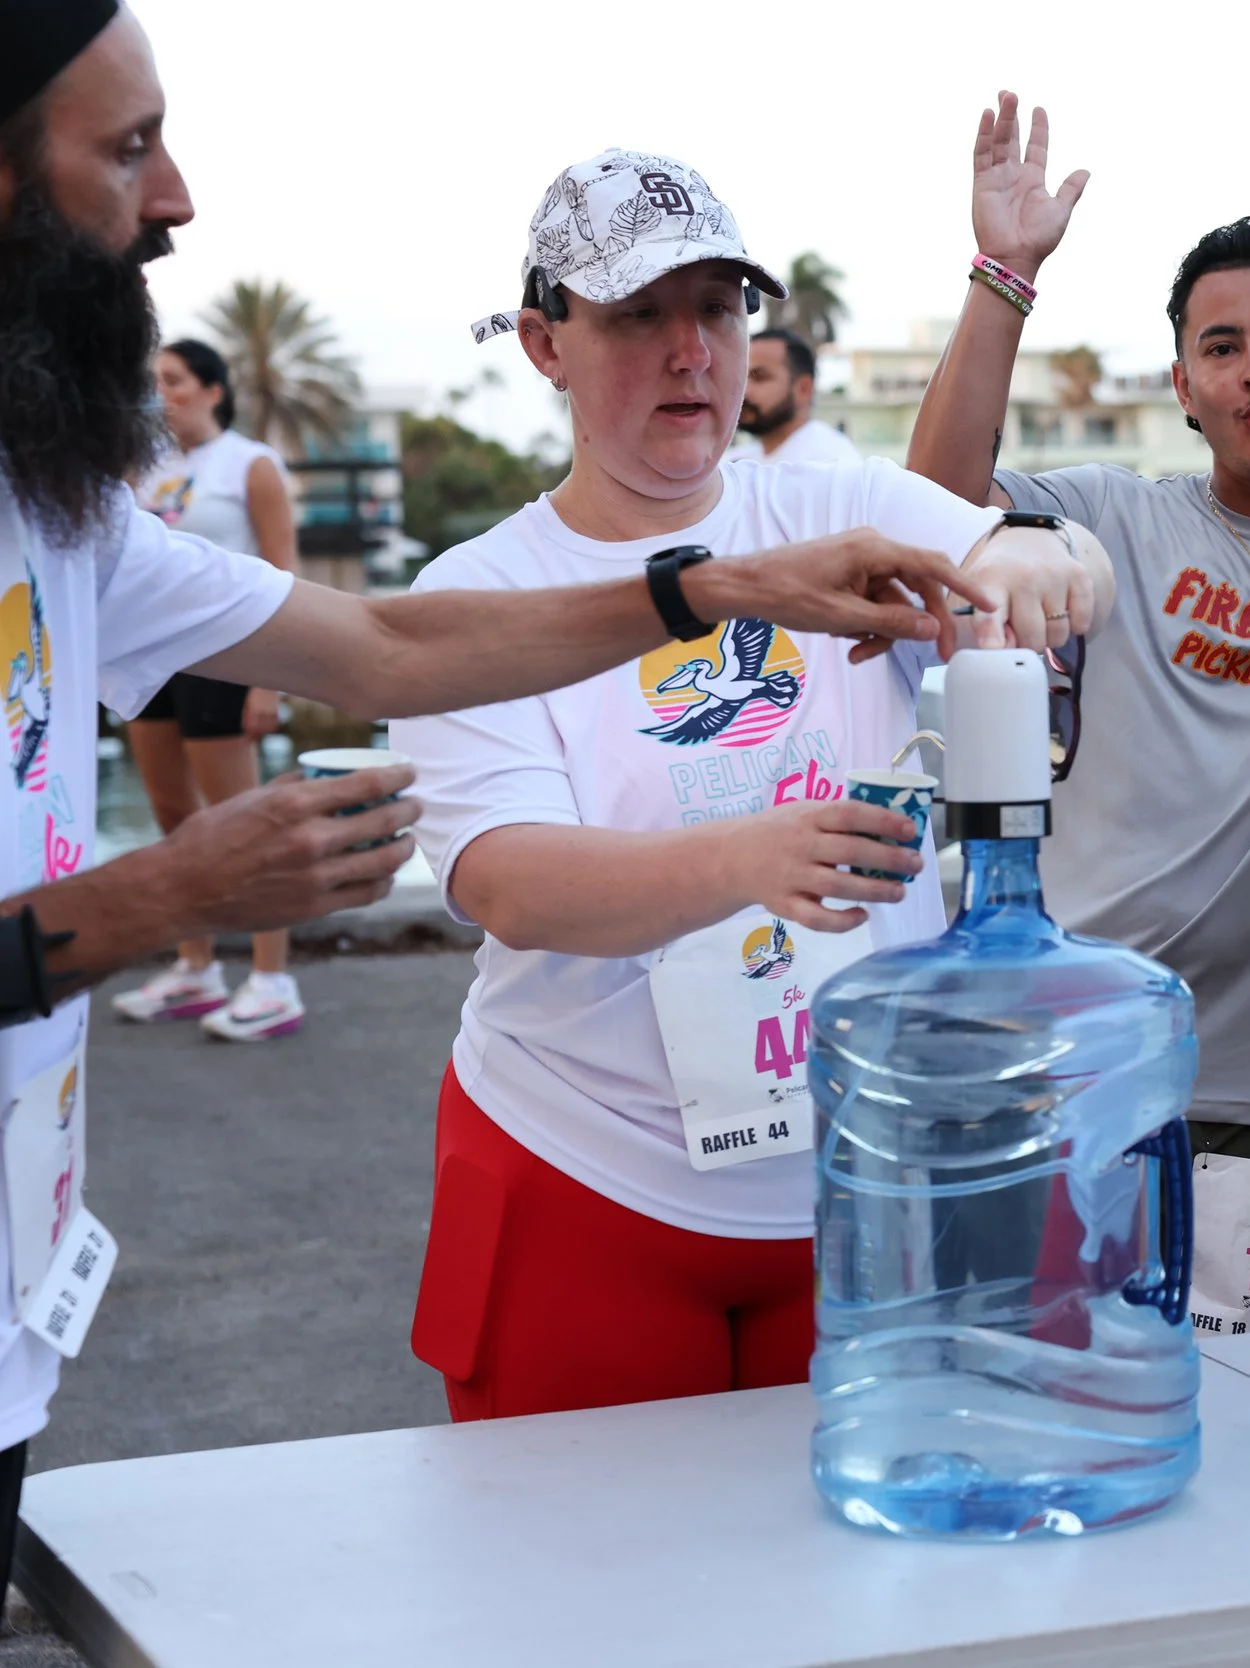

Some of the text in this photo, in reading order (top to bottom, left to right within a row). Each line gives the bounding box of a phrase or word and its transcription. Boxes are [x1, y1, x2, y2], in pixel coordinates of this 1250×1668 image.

[640, 172, 695, 216] SD
[981, 260, 1013, 281] COMBAT
[669, 730, 837, 804] PELICAN
[701, 1120, 789, 1155] RAFFLE 44
[1190, 1312, 1247, 1335] AFFLE 18
